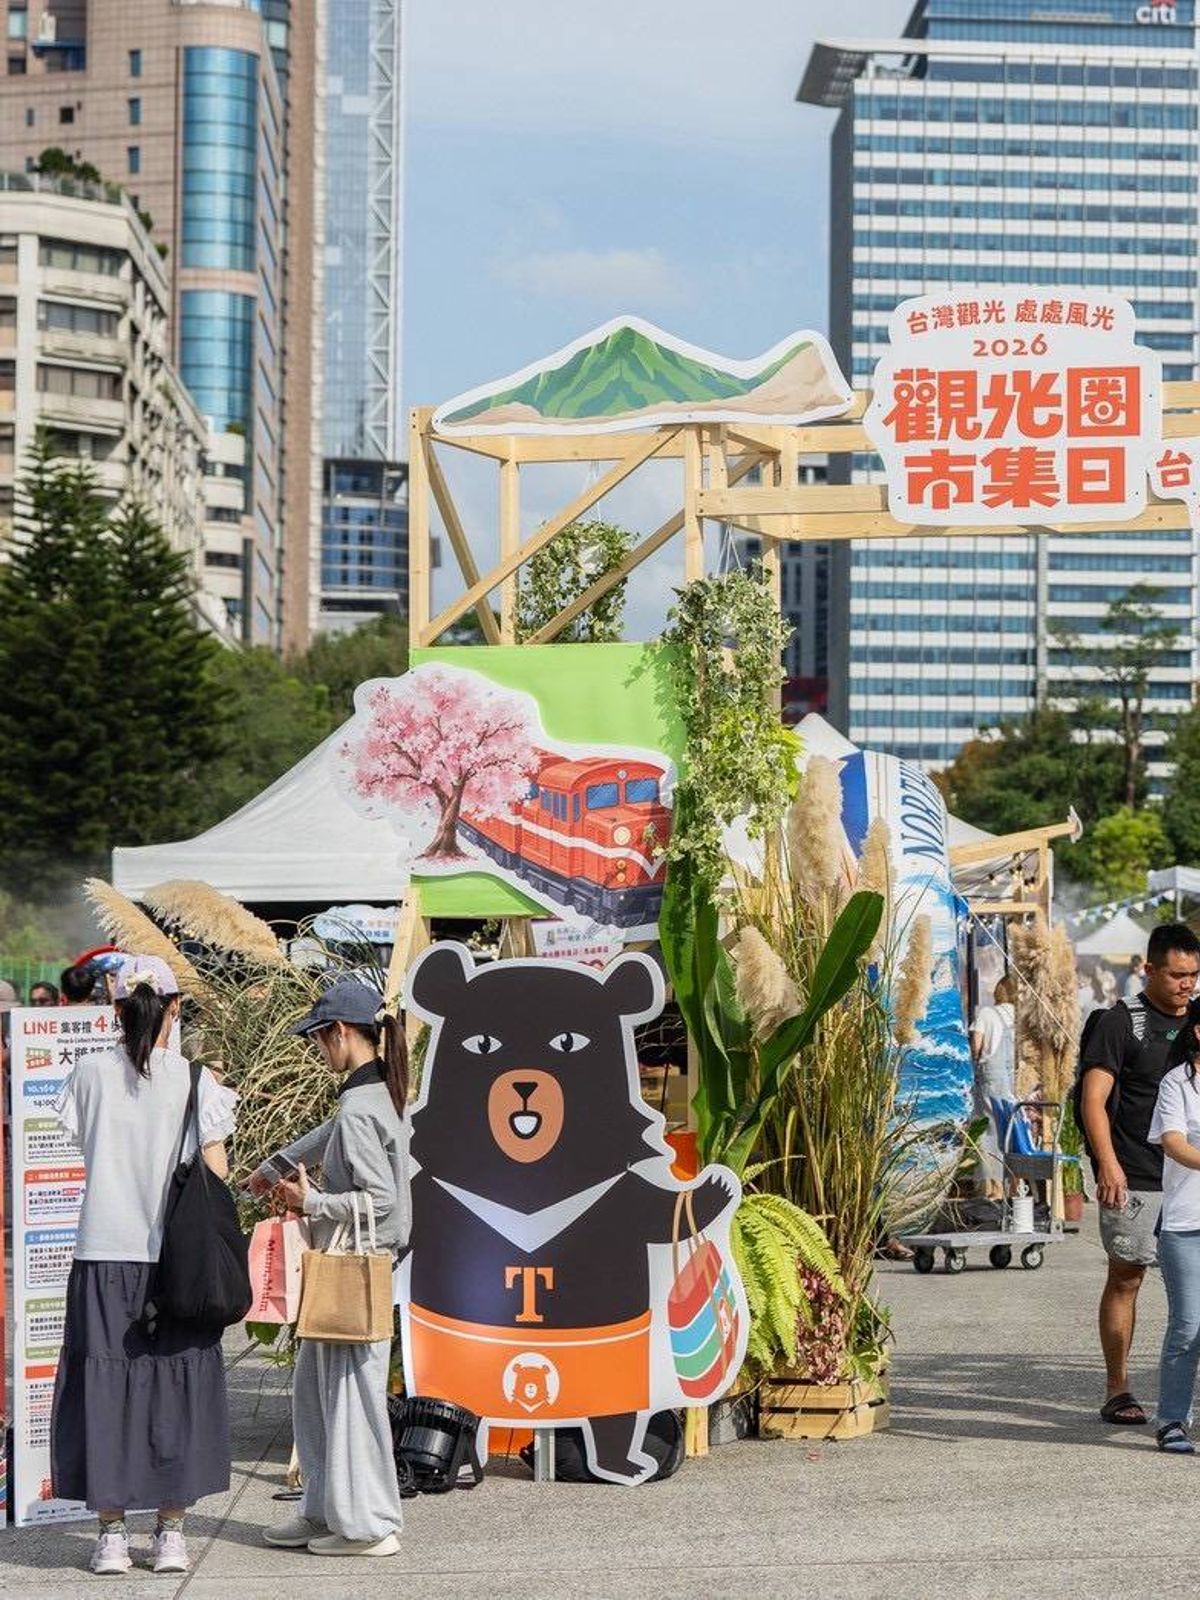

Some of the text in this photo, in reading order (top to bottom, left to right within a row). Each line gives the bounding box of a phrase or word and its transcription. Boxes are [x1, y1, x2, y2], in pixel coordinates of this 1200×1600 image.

[1136, 3, 1176, 25] citi
[907, 299, 1115, 335] 台灣觀光 處處風光
[972, 333, 1048, 357] 2026
[882, 366, 1141, 443] 觀光圈
[904, 446, 1126, 510] 市集日
[24, 1020, 58, 1035] LINE
[94, 1015, 107, 1033] 4
[504, 1266, 554, 1322] T
